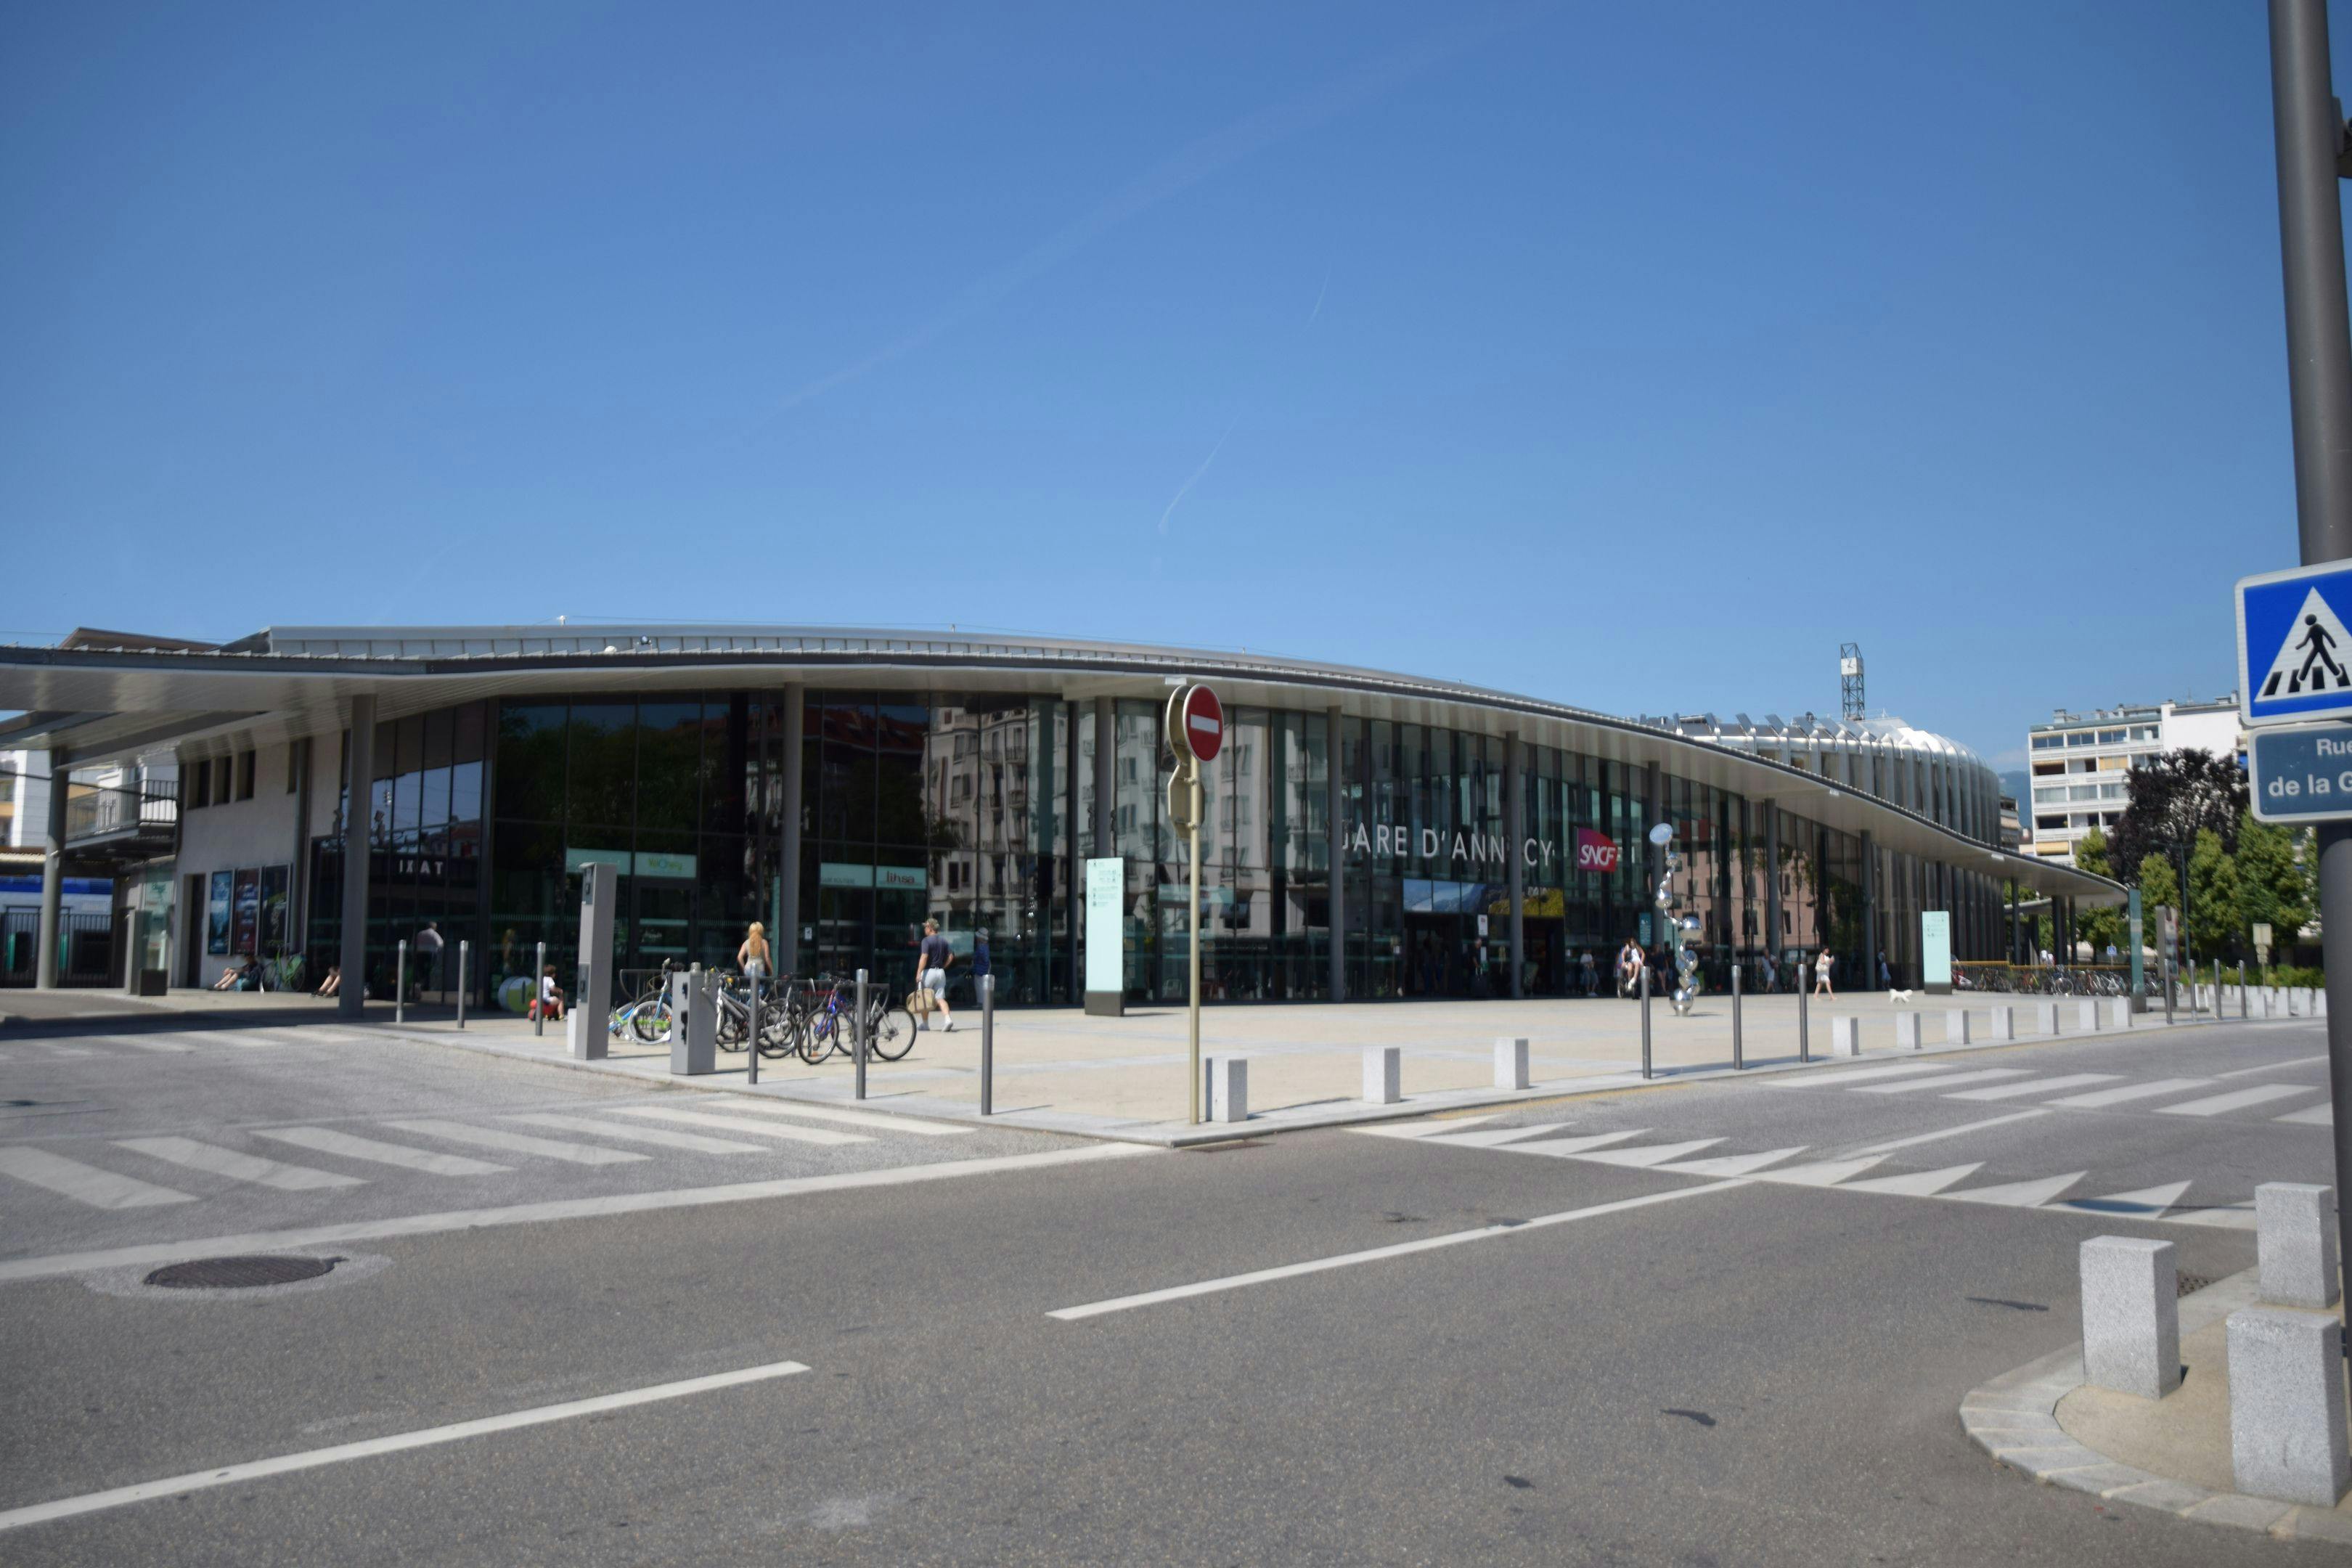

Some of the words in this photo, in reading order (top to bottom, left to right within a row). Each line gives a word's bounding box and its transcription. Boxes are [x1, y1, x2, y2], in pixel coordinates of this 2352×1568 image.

[2268, 775, 2300, 797] de
[2308, 774, 2330, 794] la
[1422, 828, 1552, 867] D'ANNCY
[1579, 844, 1616, 866] SNCF
